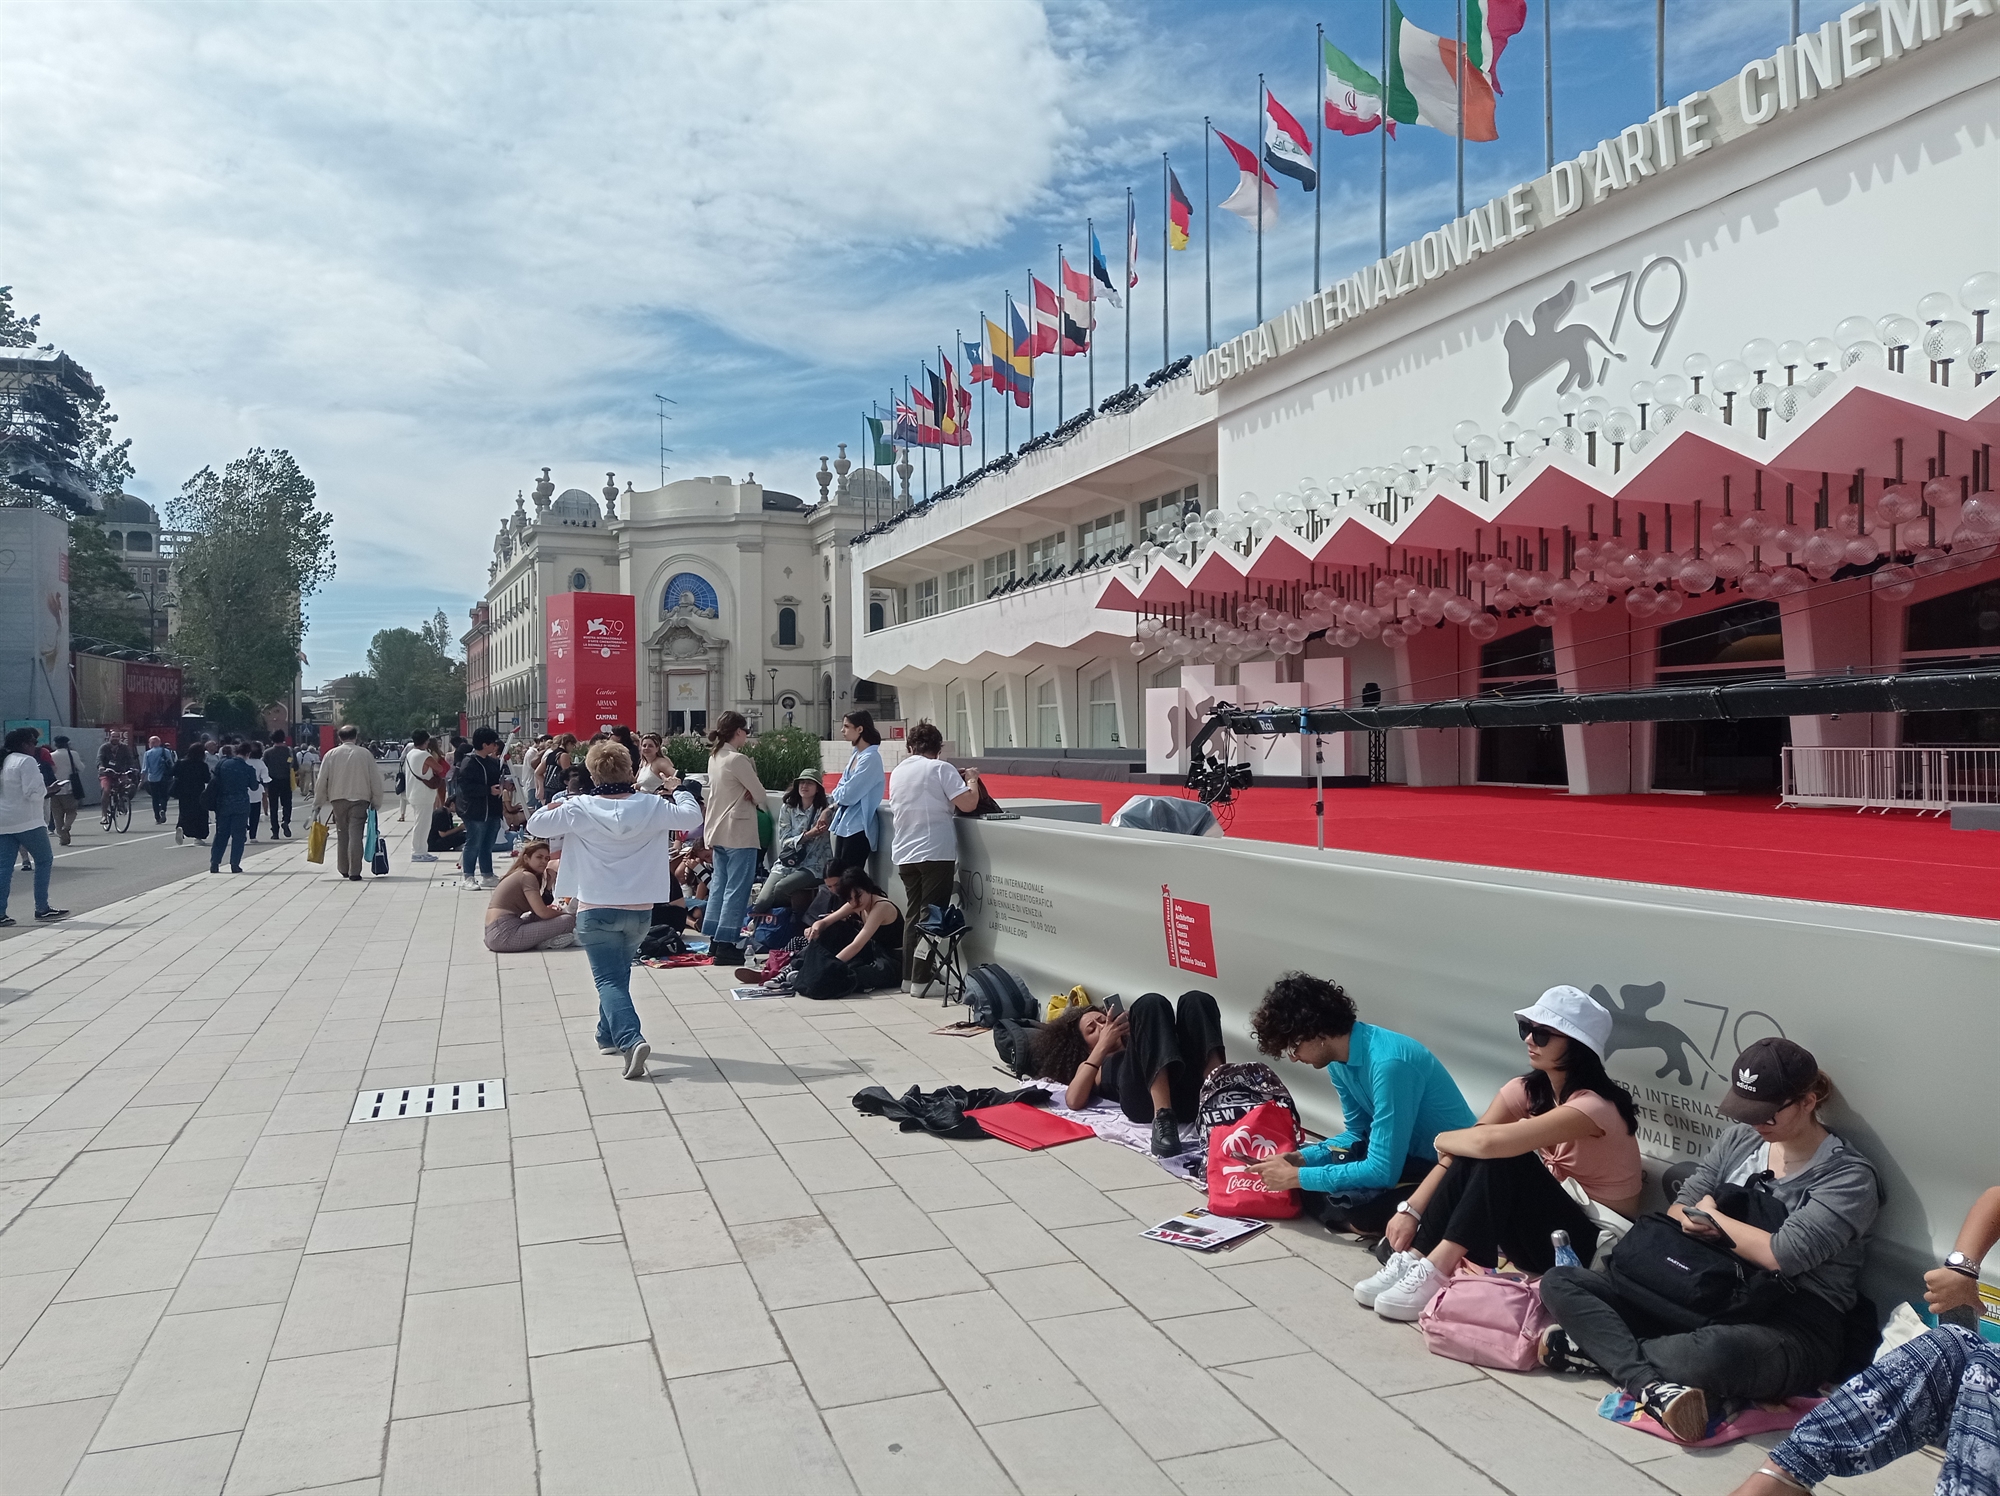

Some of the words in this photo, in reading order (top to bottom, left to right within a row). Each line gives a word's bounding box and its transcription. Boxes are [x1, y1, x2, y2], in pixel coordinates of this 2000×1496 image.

[1190, 322, 1277, 395] MOSTRA
[1284, 183, 1535, 350] INTERNAZIONALE
[1551, 91, 1712, 218] D'ARTE
[1590, 256, 1688, 386] 79
[605, 619, 625, 636] 79
[595, 687, 617, 696] Cartier
[1258, 719, 1275, 731] Rai
[986, 874, 1004, 885] MOSTRA
[1004, 877, 1044, 894] INTERNAZIONALE
[987, 897, 994, 906] LA
[994, 899, 1016, 912] BIENNALE
[1016, 904, 1022, 913] DI
[1022, 906, 1044, 919] VENEZIA
[1008, 890, 1054, 909] CINEMATOGRAFICA
[988, 921, 1028, 939] LABIENNALE.ORG
[1044, 923, 1058, 935] 2022
[1736, 1081, 1757, 1093] adidas
[1202, 1108, 1236, 1125] NEW
[1666, 1256, 1691, 1271] EASTPAK
